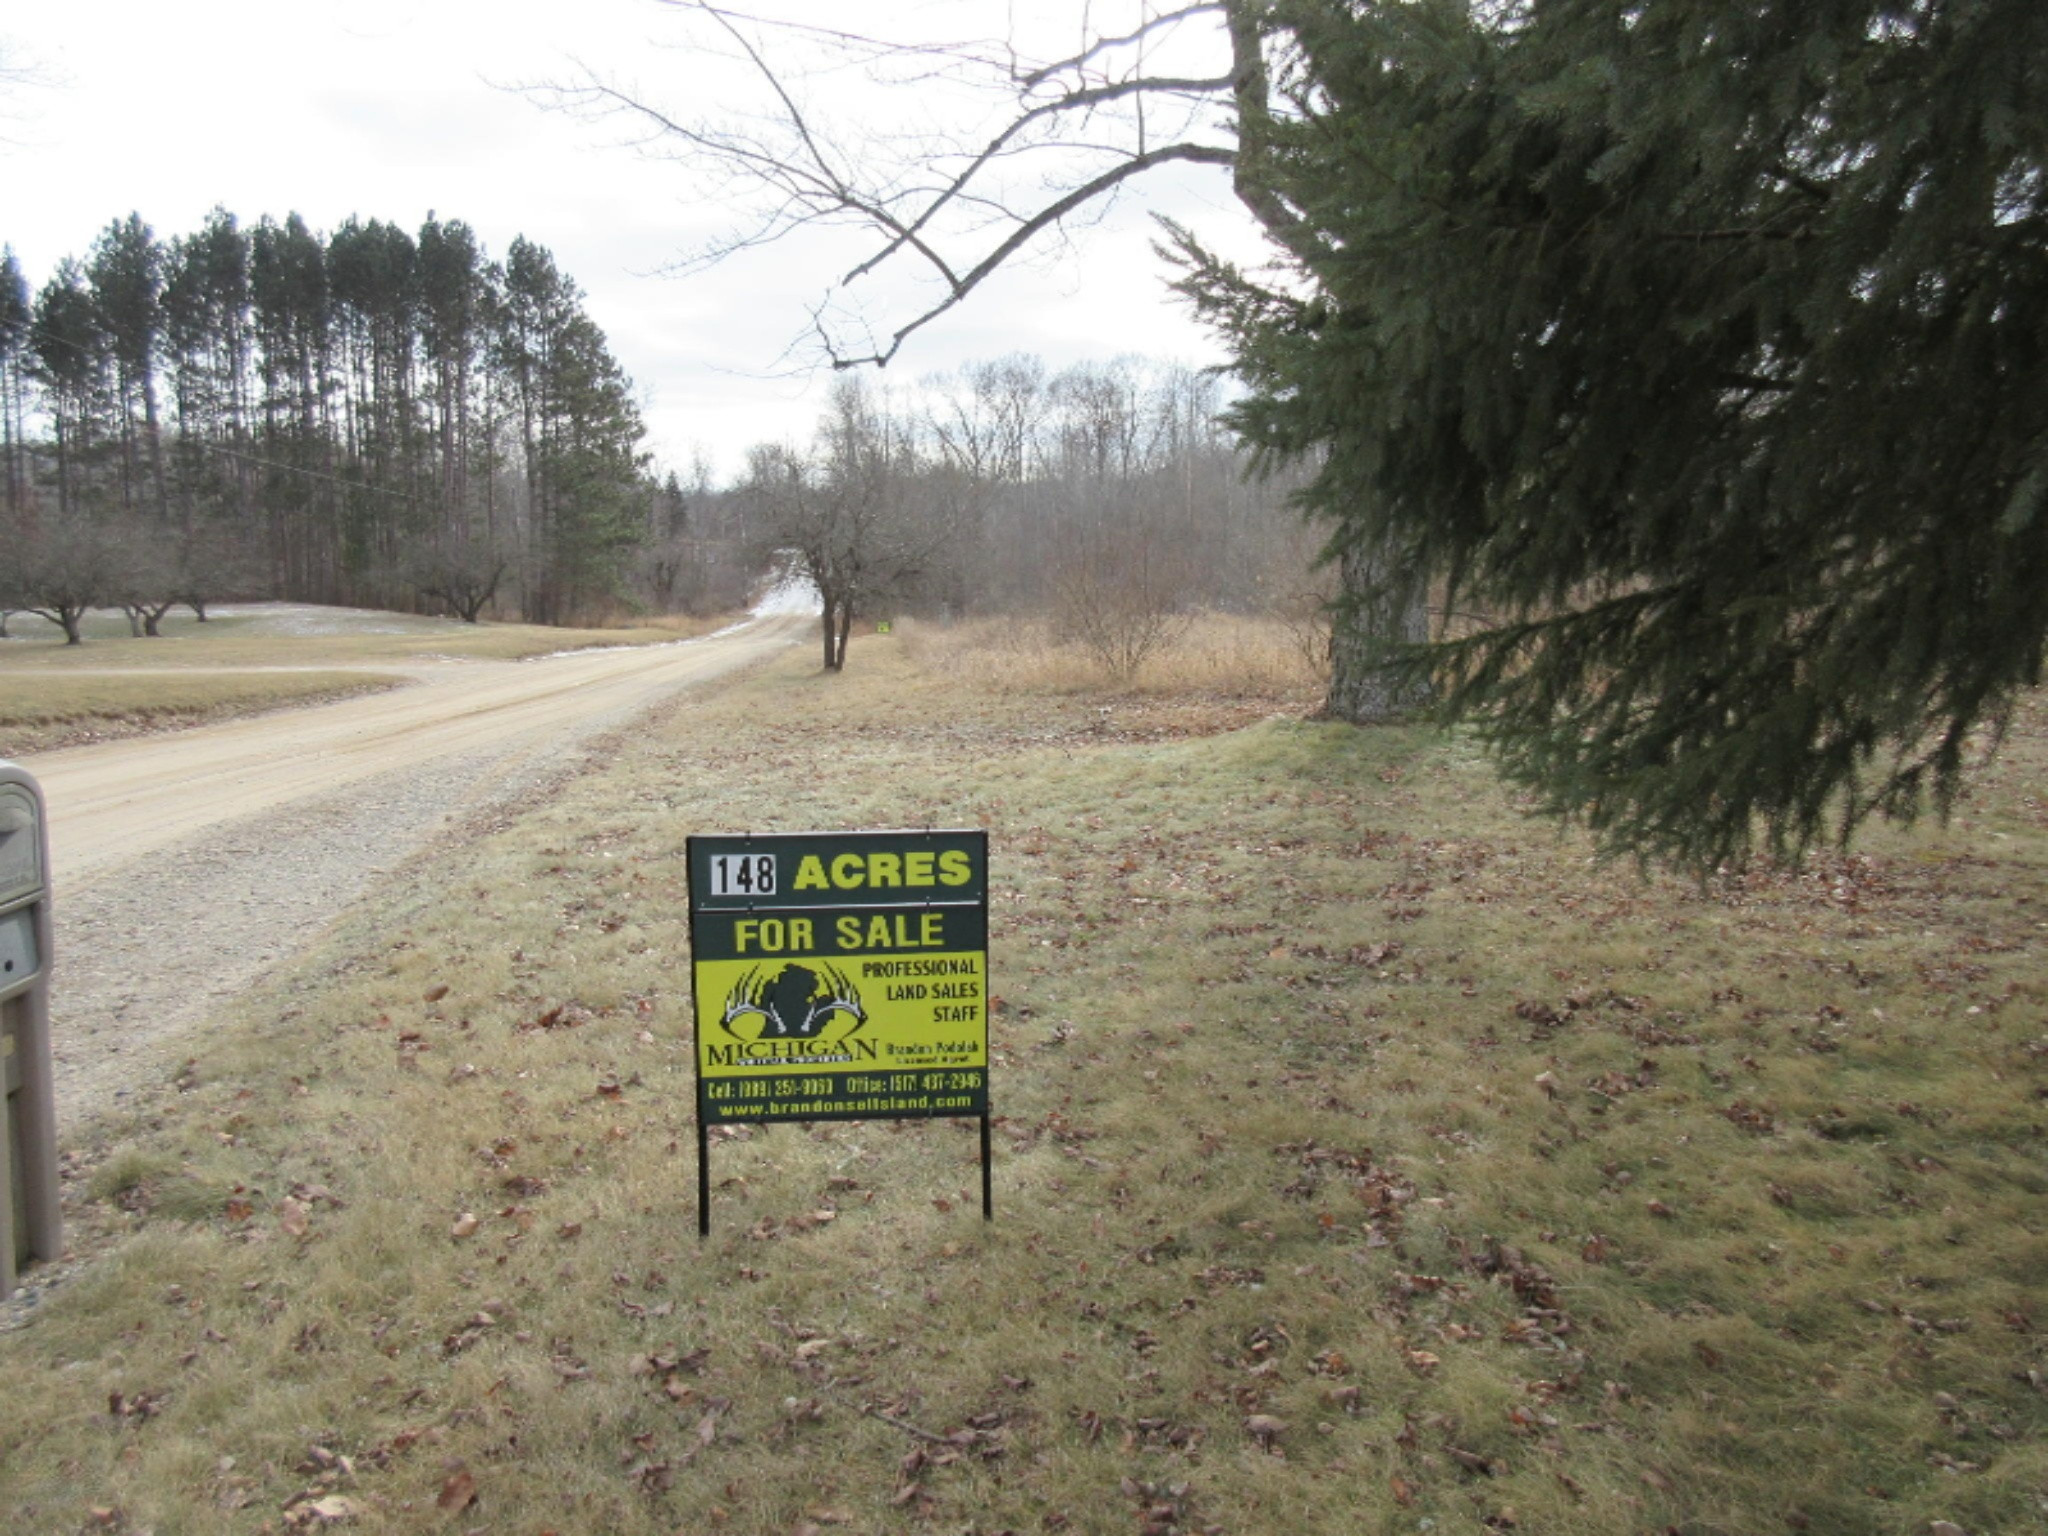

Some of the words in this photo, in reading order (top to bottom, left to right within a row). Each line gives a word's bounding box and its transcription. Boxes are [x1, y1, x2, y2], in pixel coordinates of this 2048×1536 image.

[716, 856, 774, 894] 148
[792, 850, 972, 890] ACRES
[734, 917, 815, 953] FOR
[836, 913, 944, 950] SALE
[862, 958, 978, 978] PROFESSIONAL
[887, 984, 927, 1001] LAND
[931, 981, 978, 999] SALES
[934, 1005, 978, 1022] STAFF
[706, 1038, 879, 1066] MICHIGAN
[708, 1082, 735, 1099] Cell:
[718, 1095, 972, 1116] www.brandonsellsland.com
